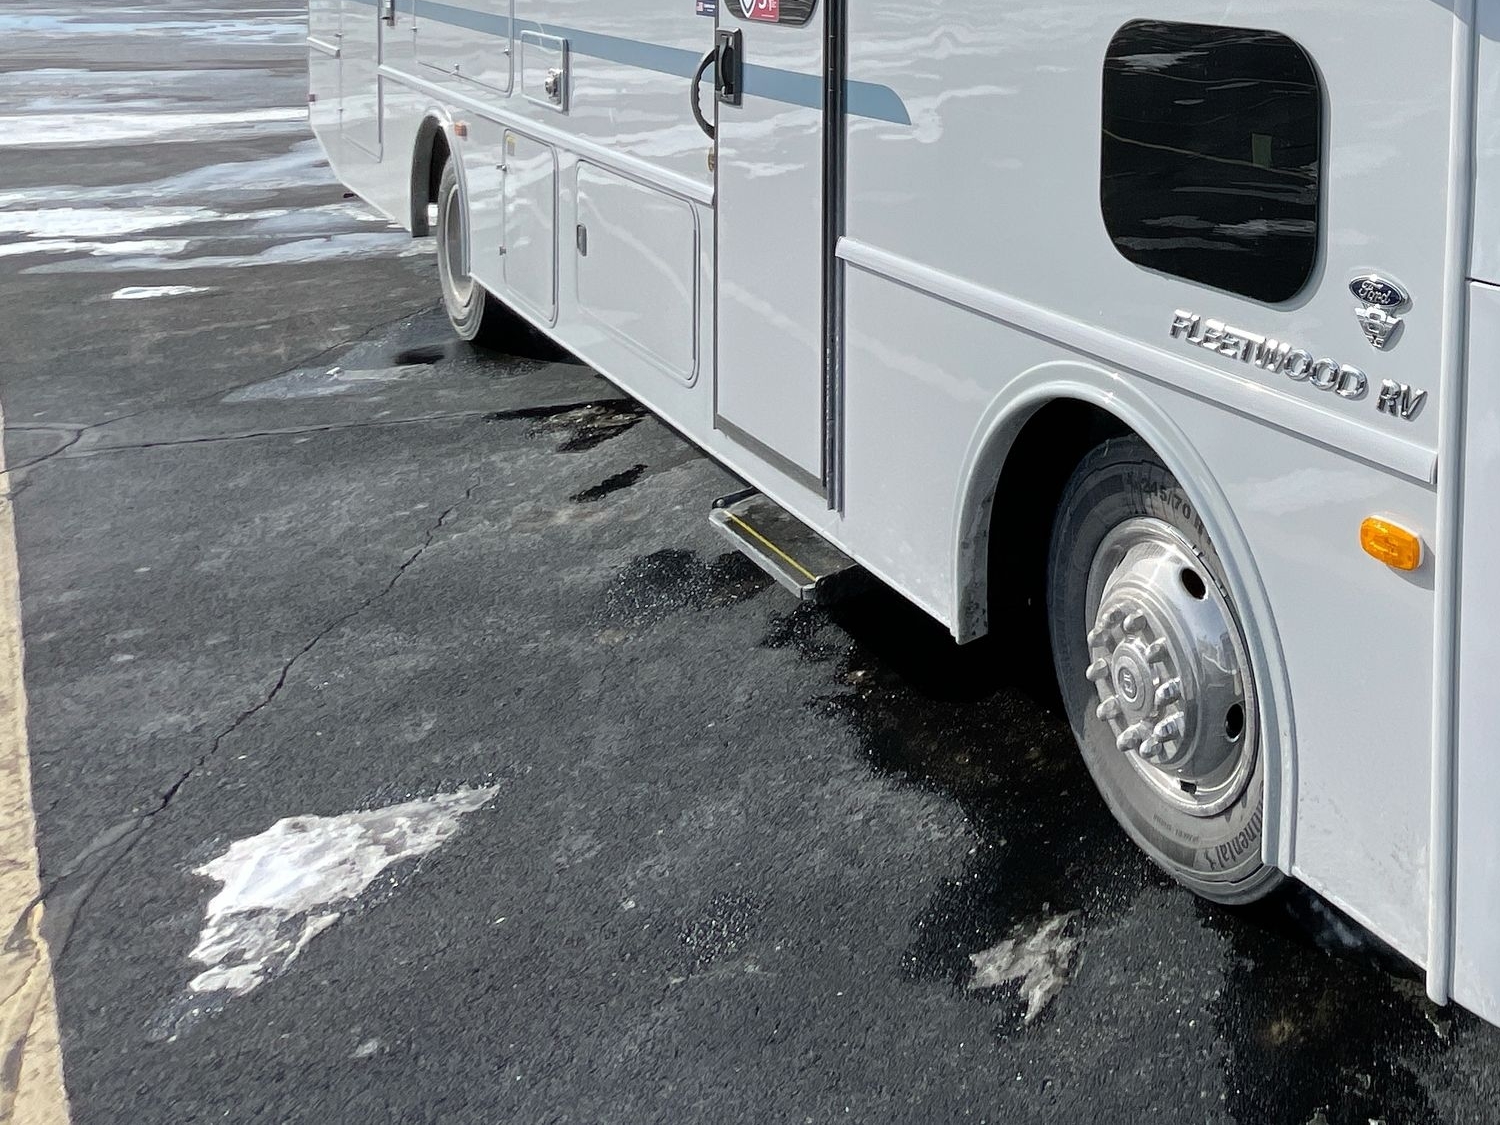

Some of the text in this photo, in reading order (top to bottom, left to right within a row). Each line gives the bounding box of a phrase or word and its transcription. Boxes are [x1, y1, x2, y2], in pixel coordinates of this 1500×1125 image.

[1358, 280, 1392, 304] Ford
[1169, 309, 1427, 421] FLEETWOOD RV
